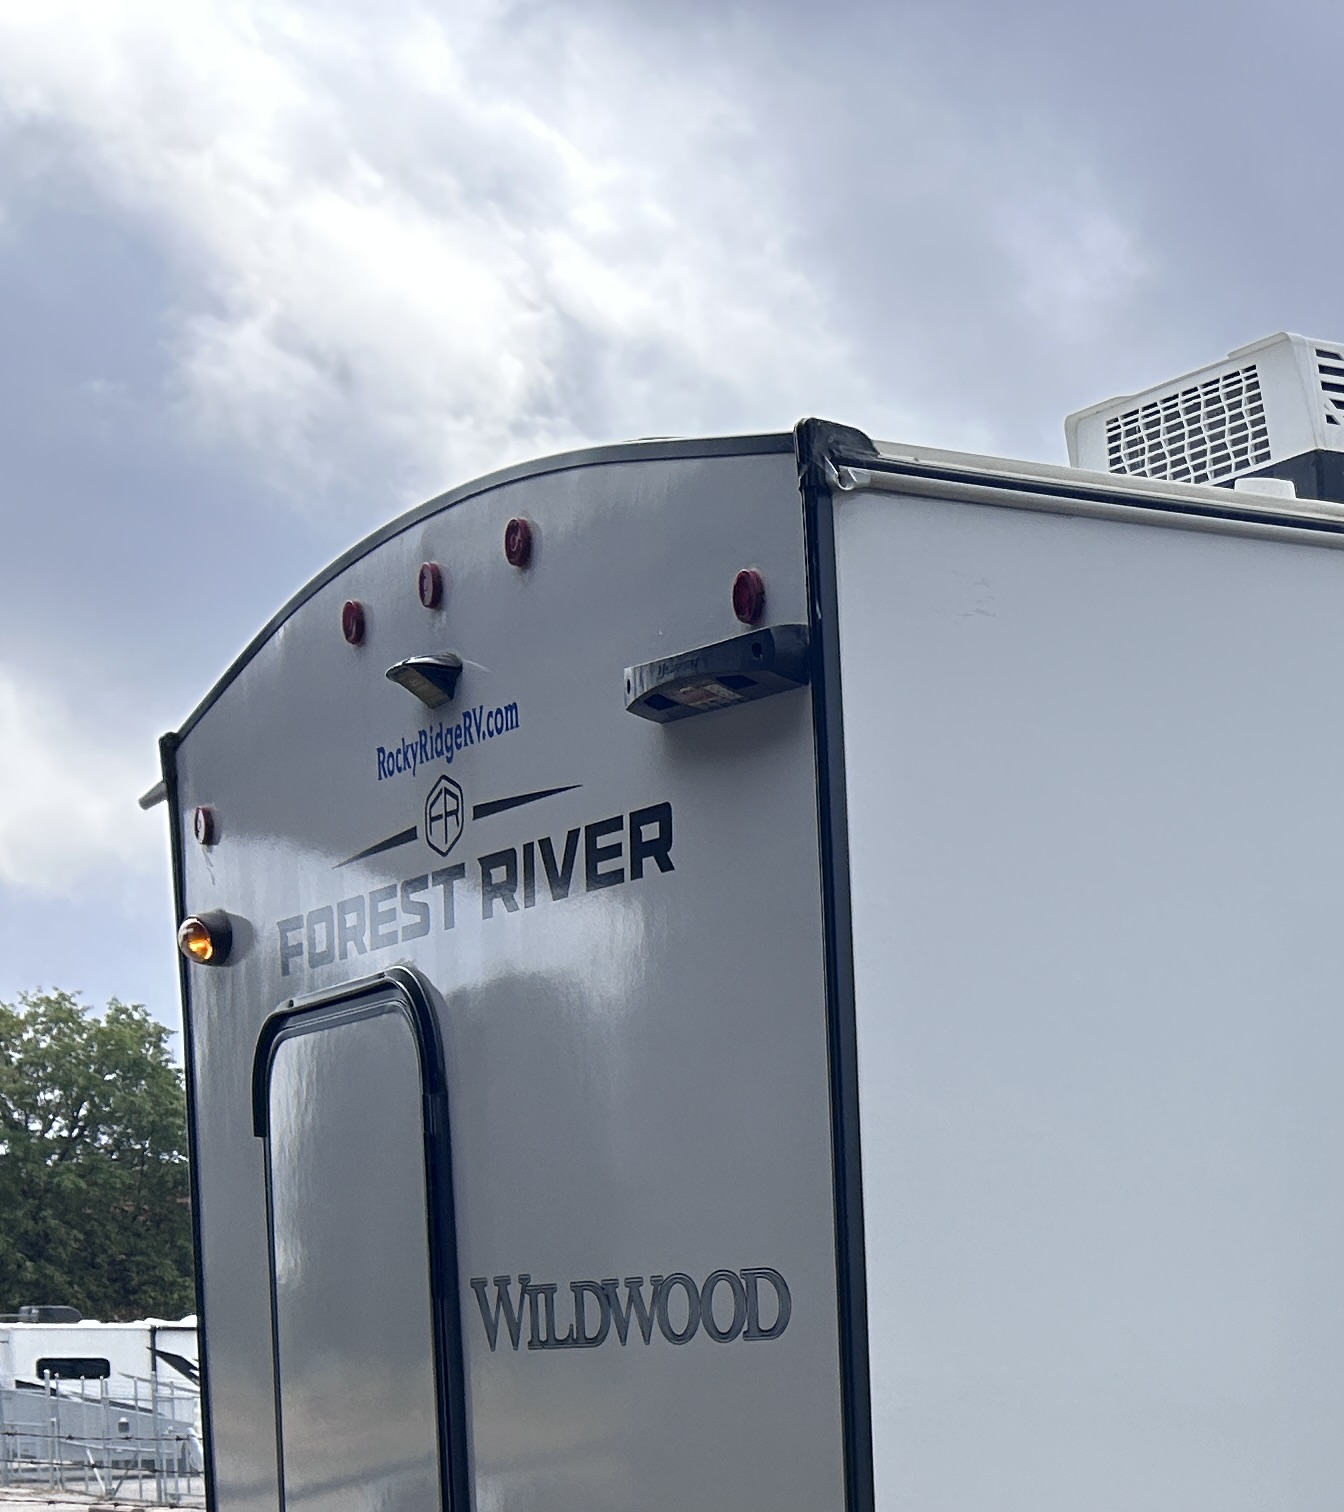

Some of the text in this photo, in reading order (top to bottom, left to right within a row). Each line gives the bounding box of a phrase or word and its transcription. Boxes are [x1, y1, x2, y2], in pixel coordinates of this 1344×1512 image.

[376, 701, 520, 781] RockyRidgeRV.com
[276, 801, 675, 977] FOREST RIVER
[470, 1267, 792, 1353] WILDWOOD
